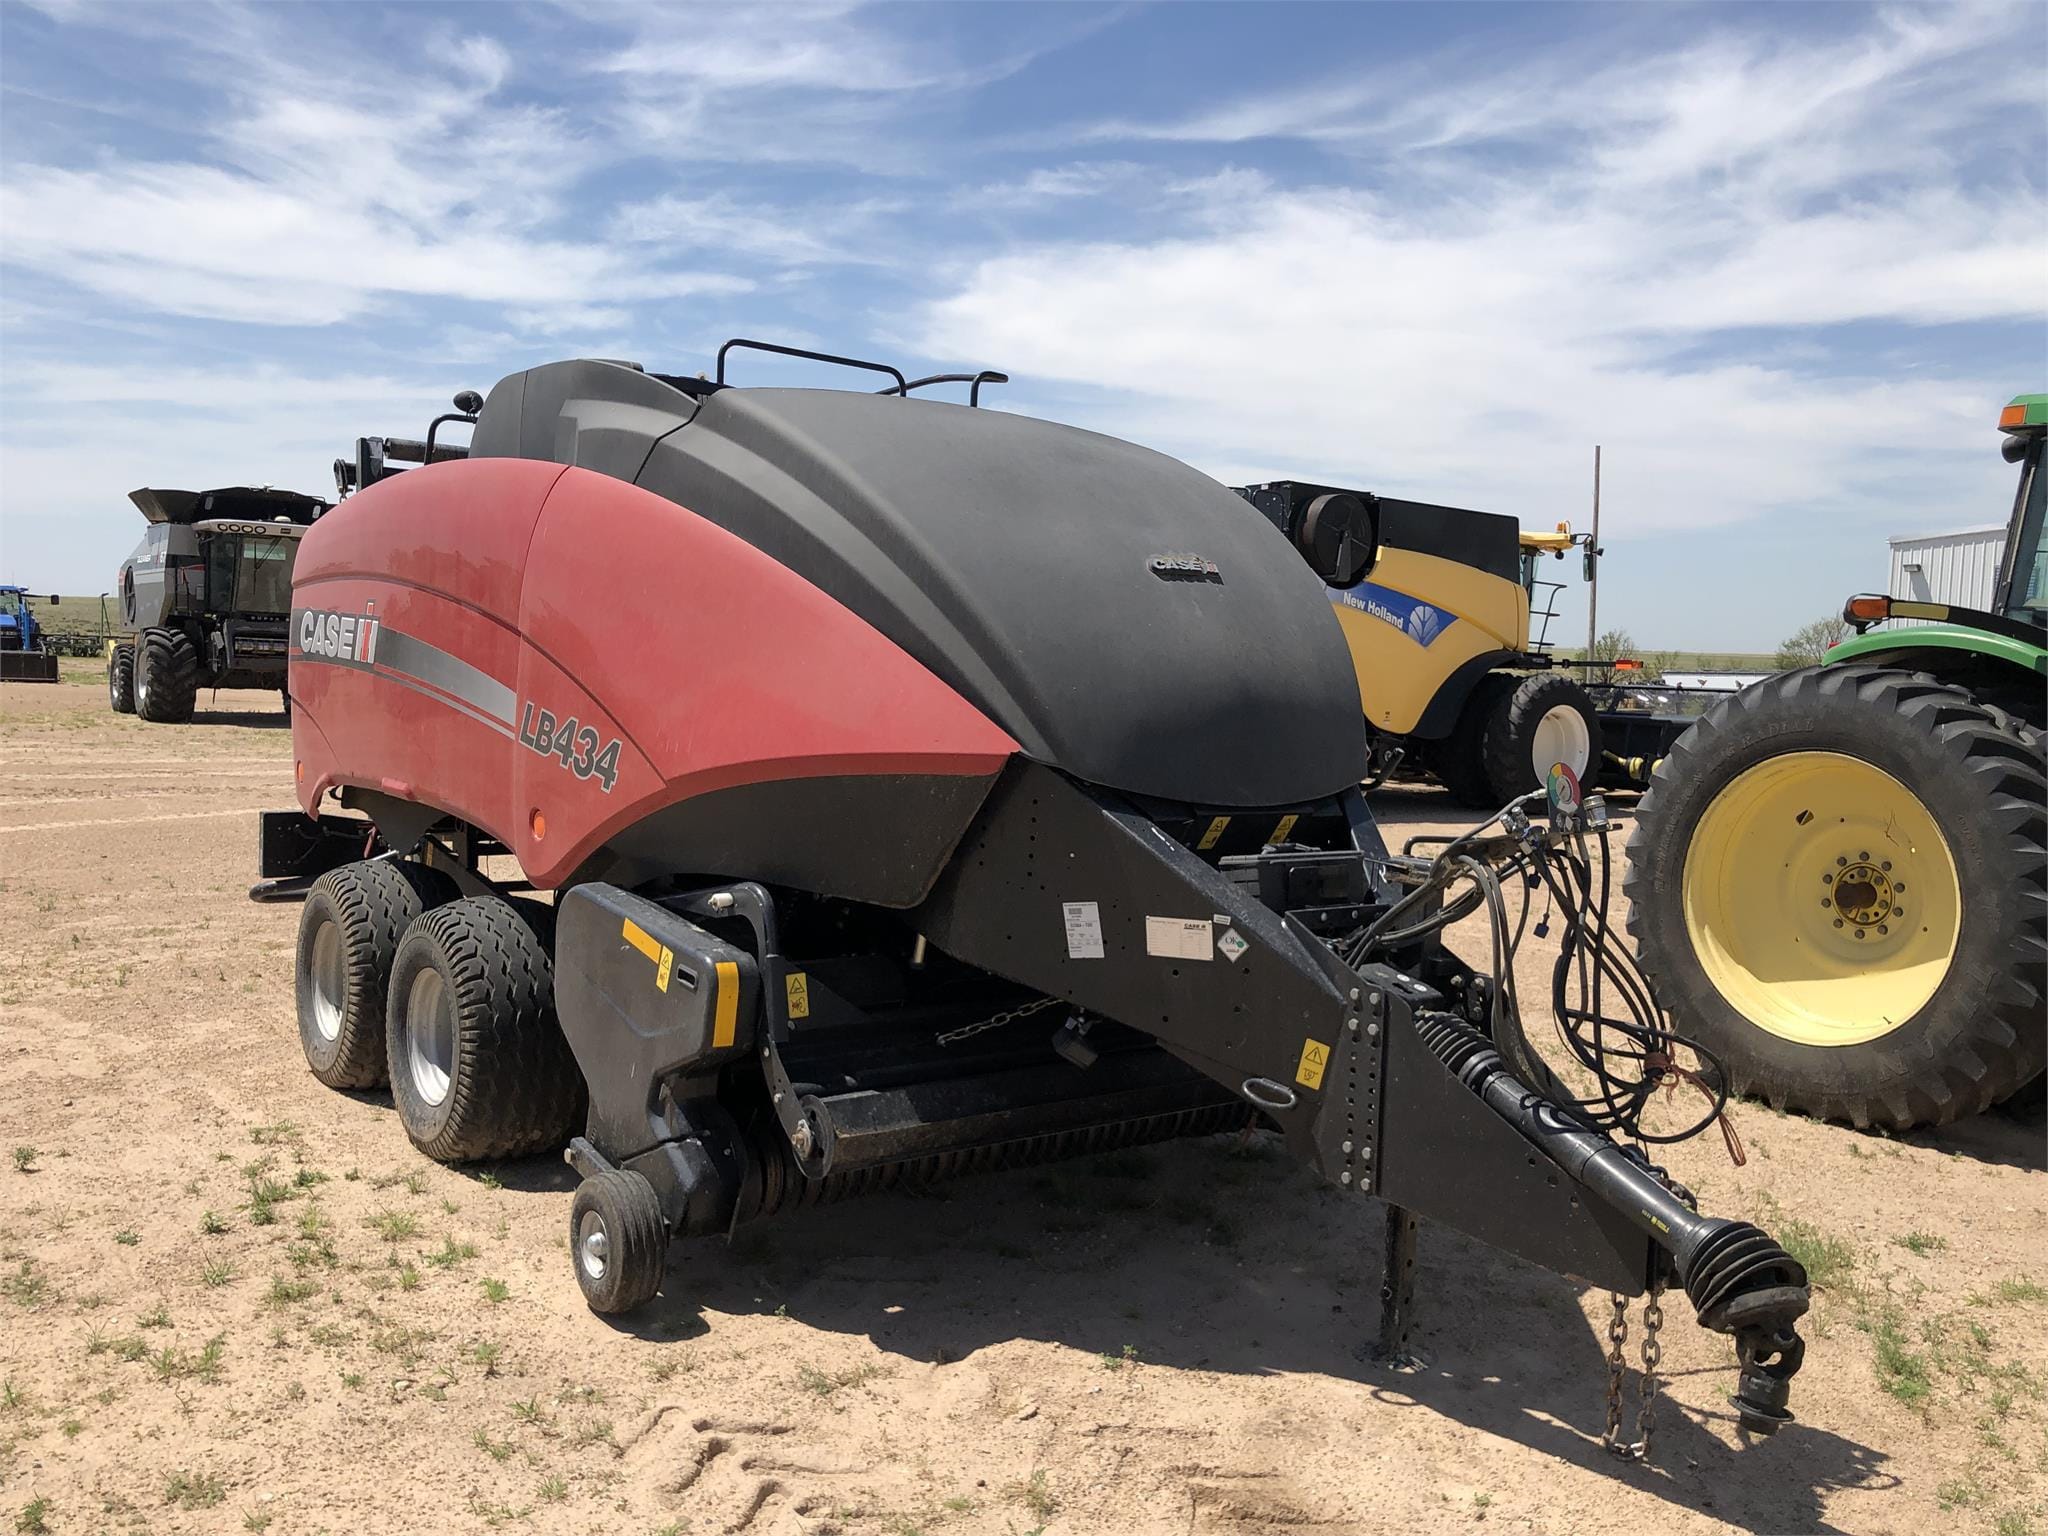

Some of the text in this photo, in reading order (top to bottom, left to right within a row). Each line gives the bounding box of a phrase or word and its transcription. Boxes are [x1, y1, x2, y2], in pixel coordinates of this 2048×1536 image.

[1152, 559, 1202, 571] CASE
[1343, 591, 1404, 630] New Holland
[300, 610, 355, 660] CASE
[519, 700, 622, 794] LB434
